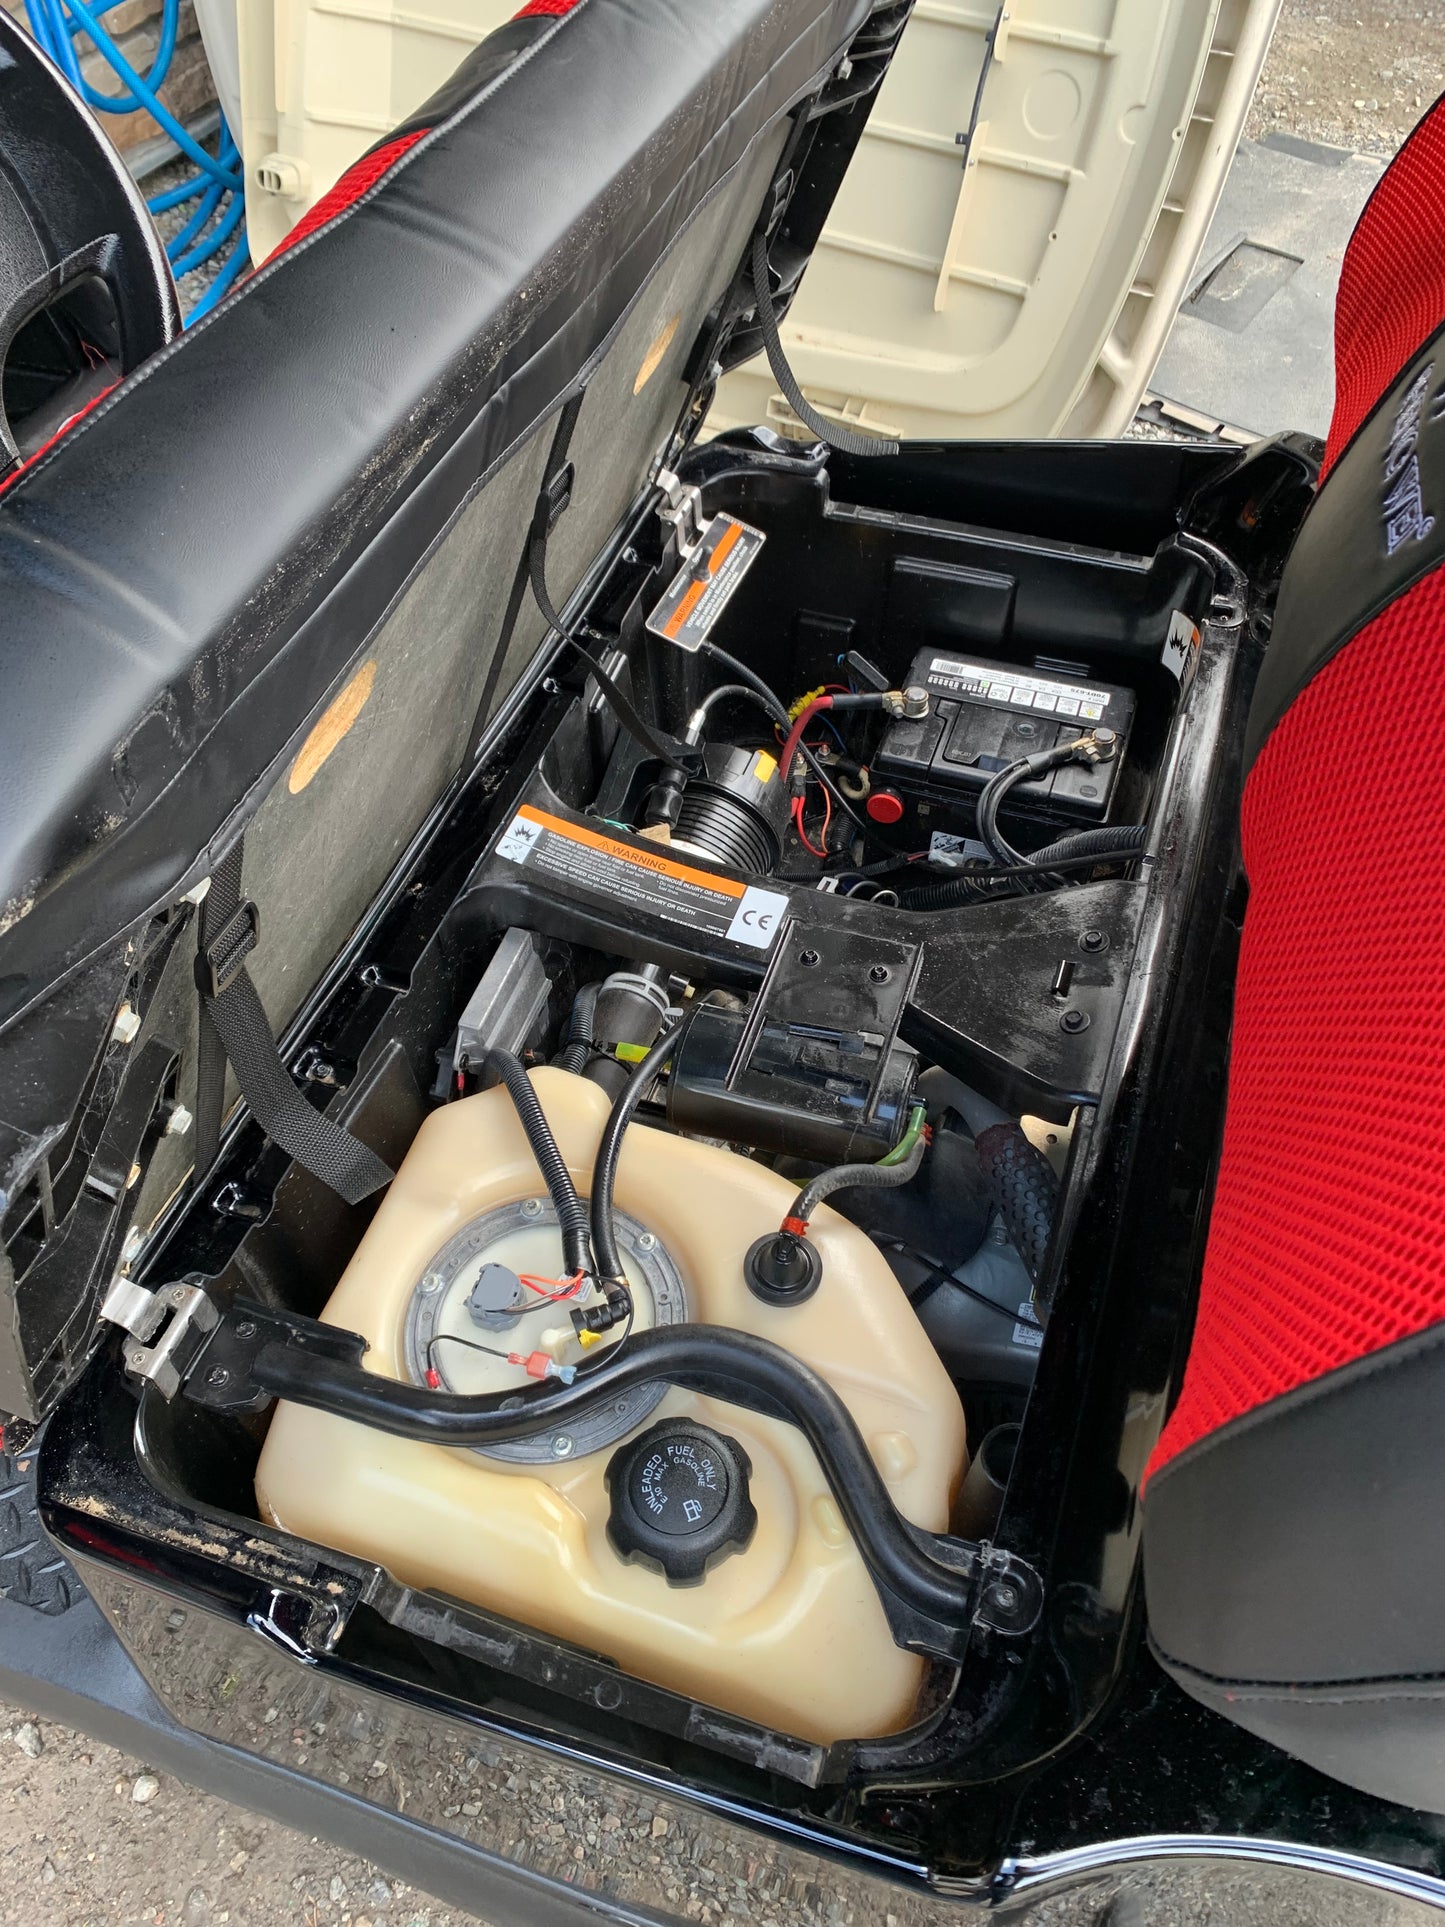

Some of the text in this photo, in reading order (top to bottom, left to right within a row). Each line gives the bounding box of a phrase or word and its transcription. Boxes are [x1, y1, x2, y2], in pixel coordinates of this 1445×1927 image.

[685, 536, 746, 628] VEHICLE MOVEMENT MAY CAUSE SERIOUS INJURY
[672, 592, 697, 623] WARNING
[553, 846, 573, 857] smoking
[555, 851, 571, 861] engine
[556, 842, 572, 851] sparks
[611, 844, 668, 872] WARNING
[546, 831, 577, 847] GASOLINE
[576, 843, 609, 859] EXPLOSION
[610, 856, 625, 865] FIRE
[624, 861, 638, 870] CAN
[636, 866, 657, 877] CAUSE
[657, 873, 683, 886] SERIOUS
[682, 882, 704, 892] INJURY
[712, 892, 733, 902] DEATH
[567, 872, 578, 880] with
[576, 876, 593, 886] engine
[535, 852, 568, 869] EXCESSIVE
[567, 865, 588, 877] SPEED
[586, 873, 600, 881] CAN
[599, 878, 620, 889] CAUSE
[619, 885, 646, 898] SERIOUS
[645, 895, 667, 906] INJURY
[675, 905, 696, 915] DEATH
[674, 885, 700, 897] disconnect
[699, 893, 727, 905] pressurized
[742, 909, 773, 931] CE
[641, 1445, 717, 1515] UNLEADED FUEL ONLY
[654, 1461, 669, 1481] MAX
[673, 1456, 706, 1487] GASOLINE
